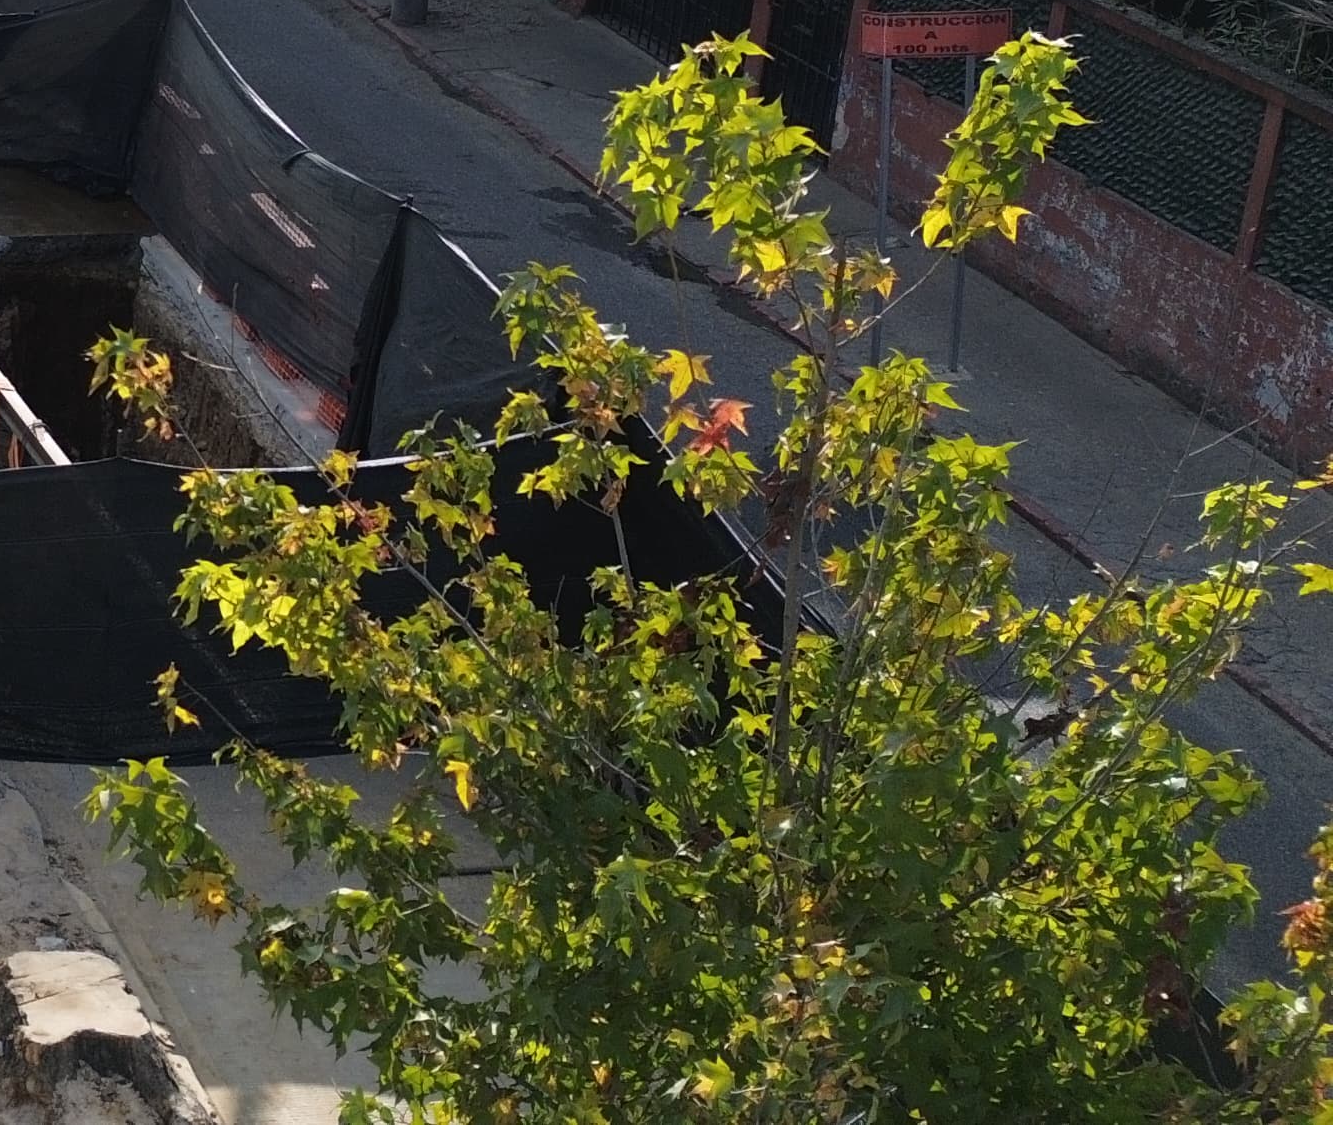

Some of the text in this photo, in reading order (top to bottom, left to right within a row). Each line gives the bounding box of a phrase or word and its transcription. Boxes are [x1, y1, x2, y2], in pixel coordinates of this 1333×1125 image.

[925, 31, 937, 40] A
[893, 44, 969, 54] 100 mts
